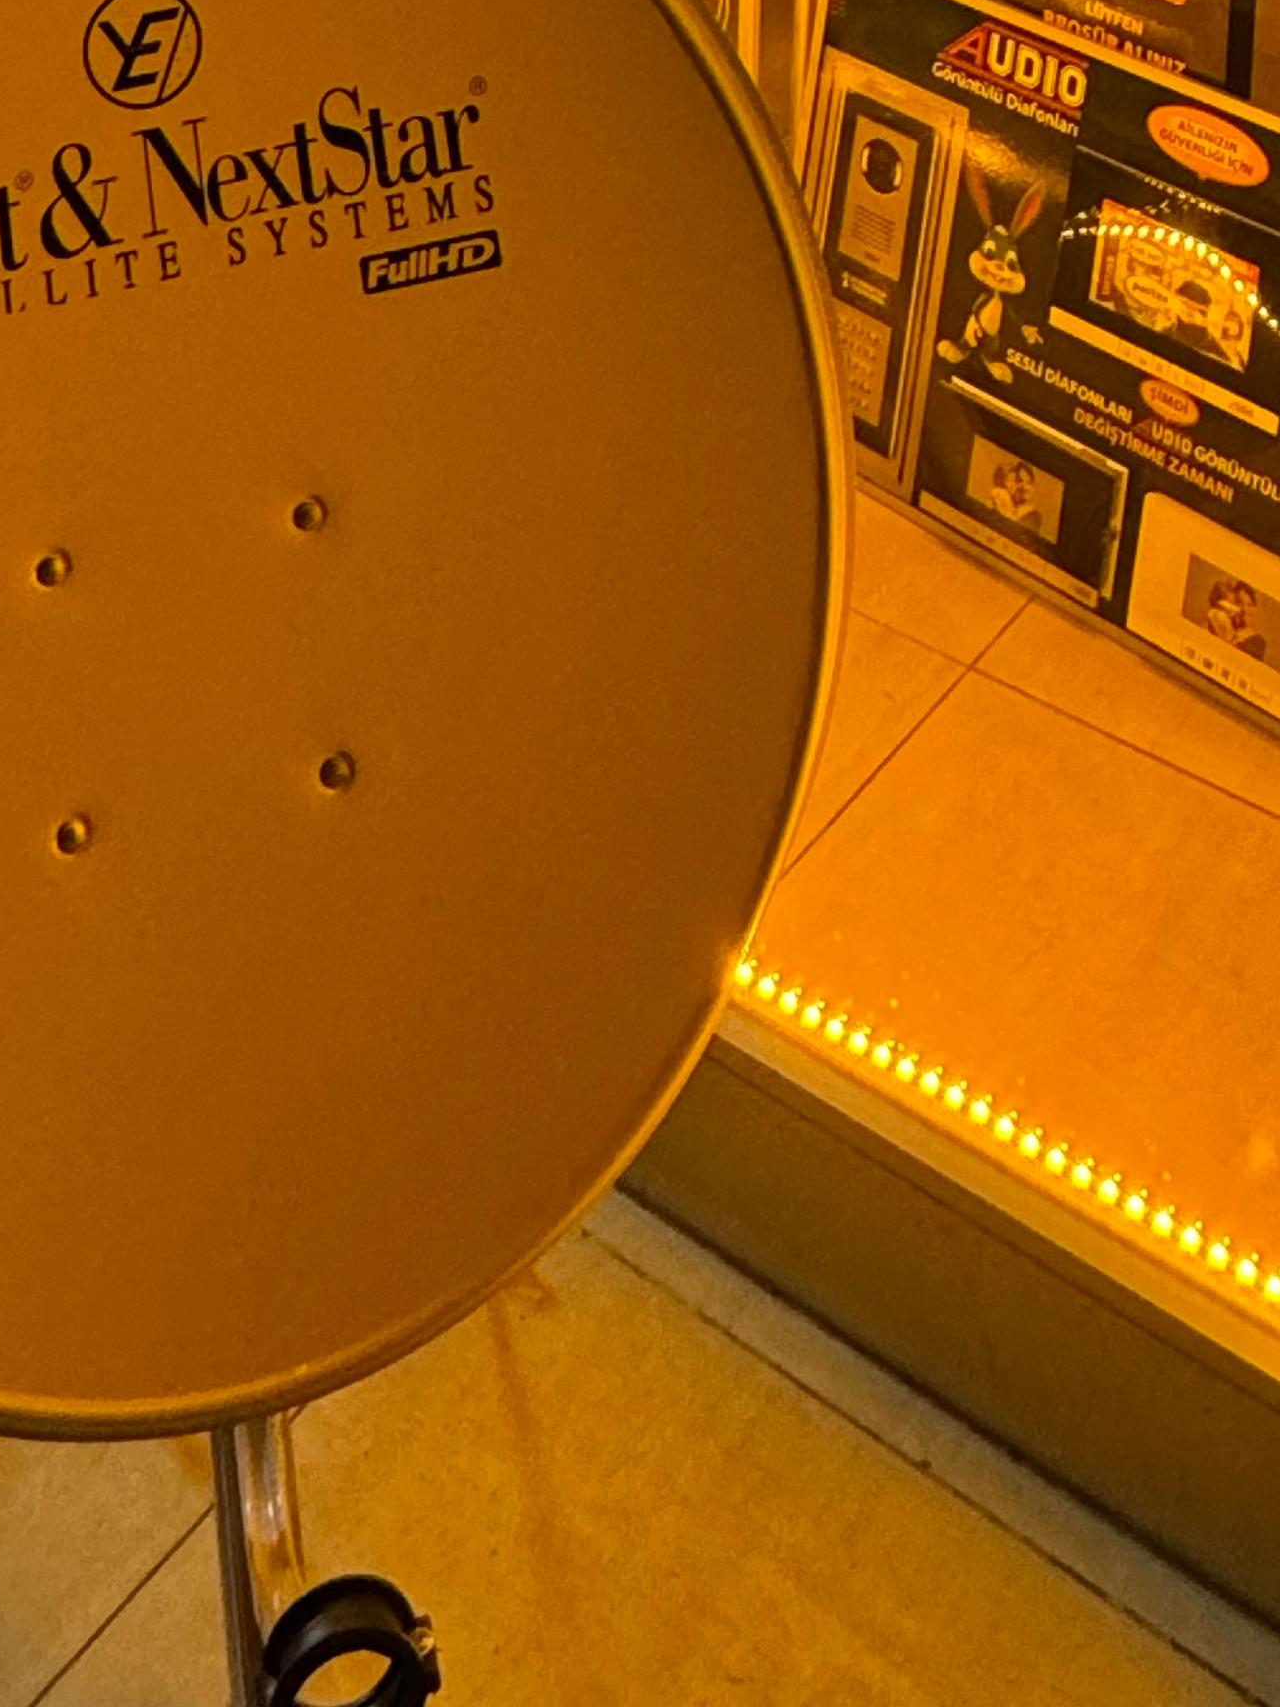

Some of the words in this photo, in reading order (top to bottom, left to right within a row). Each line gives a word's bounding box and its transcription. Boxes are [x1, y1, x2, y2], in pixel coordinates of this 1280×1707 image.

[942, 23, 1088, 108] AUDIO
[1005, 91, 1081, 138] Diafonları
[39, 142, 124, 262] &
[228, 173, 496, 268] SYSTEMS
[1005, 346, 1044, 379] SESLİ
[1044, 366, 1133, 424] DİAFONLARI
[1072, 406, 1167, 467] DEĞİŞTİRME
[1167, 454, 1236, 504] ZAMANI
